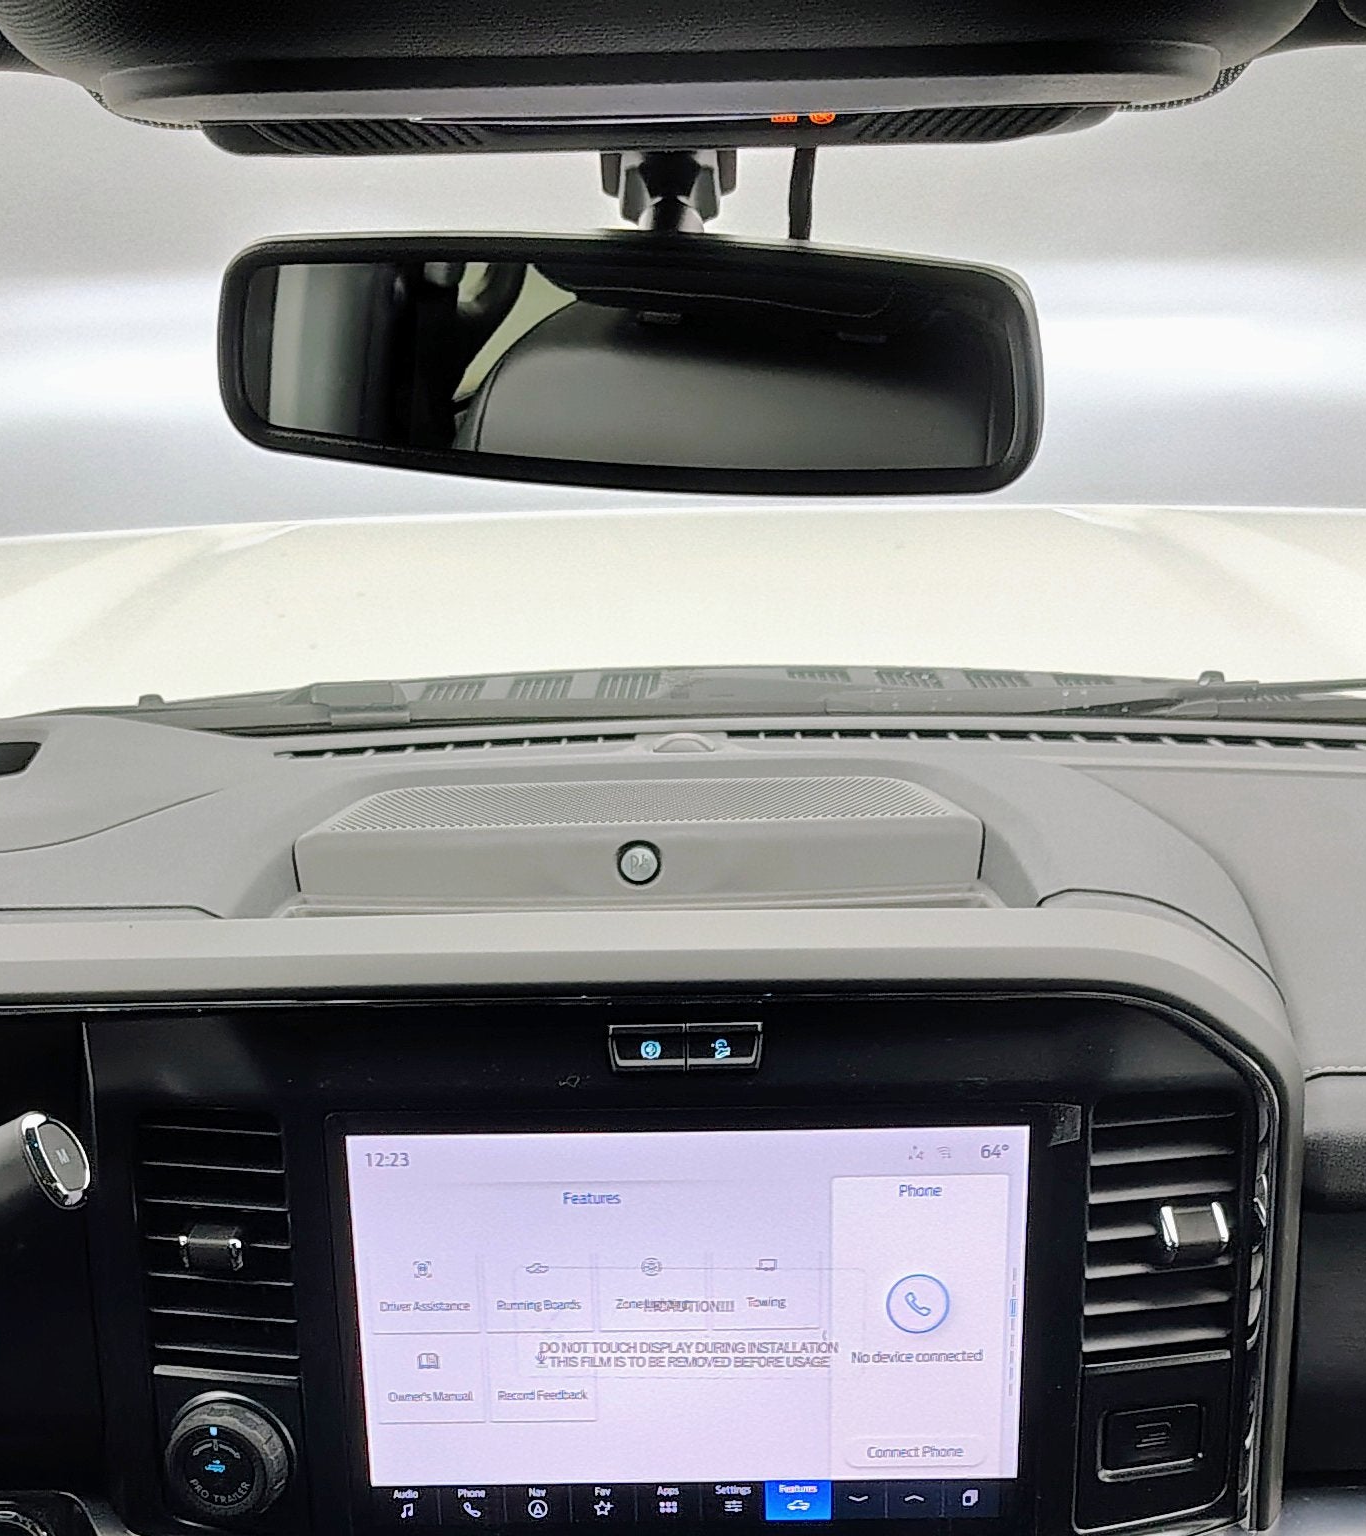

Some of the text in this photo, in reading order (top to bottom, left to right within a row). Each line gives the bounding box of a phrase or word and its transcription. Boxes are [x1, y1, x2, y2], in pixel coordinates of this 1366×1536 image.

[365, 1152, 410, 1167] 12:23
[899, 1184, 943, 1198] Phone
[562, 1191, 622, 1205] Features
[379, 1300, 470, 1312] Driver Assistance
[497, 1300, 582, 1312] Running Boards
[746, 1297, 787, 1309] Towing
[539, 1341, 838, 1354] DO NOT TOUCH DISPLAY DURING INSTALLATION
[550, 1356, 831, 1368] THIS FILM IS TO BE REMOVED BEFORE USAGE
[851, 1350, 984, 1363] No device connected
[388, 1391, 473, 1402] Owner's Manual
[497, 1390, 588, 1401] Record Feedback
[866, 1445, 964, 1459] Connect Phone
[190, 1478, 251, 1504] PRO TRAILER
[393, 1489, 419, 1499] Audio
[458, 1488, 485, 1499] Phone
[528, 1488, 546, 1498] Nav
[594, 1487, 611, 1497] Fav
[657, 1487, 680, 1498] Apps
[715, 1485, 752, 1497] Settings
[778, 1485, 818, 1494] Features
